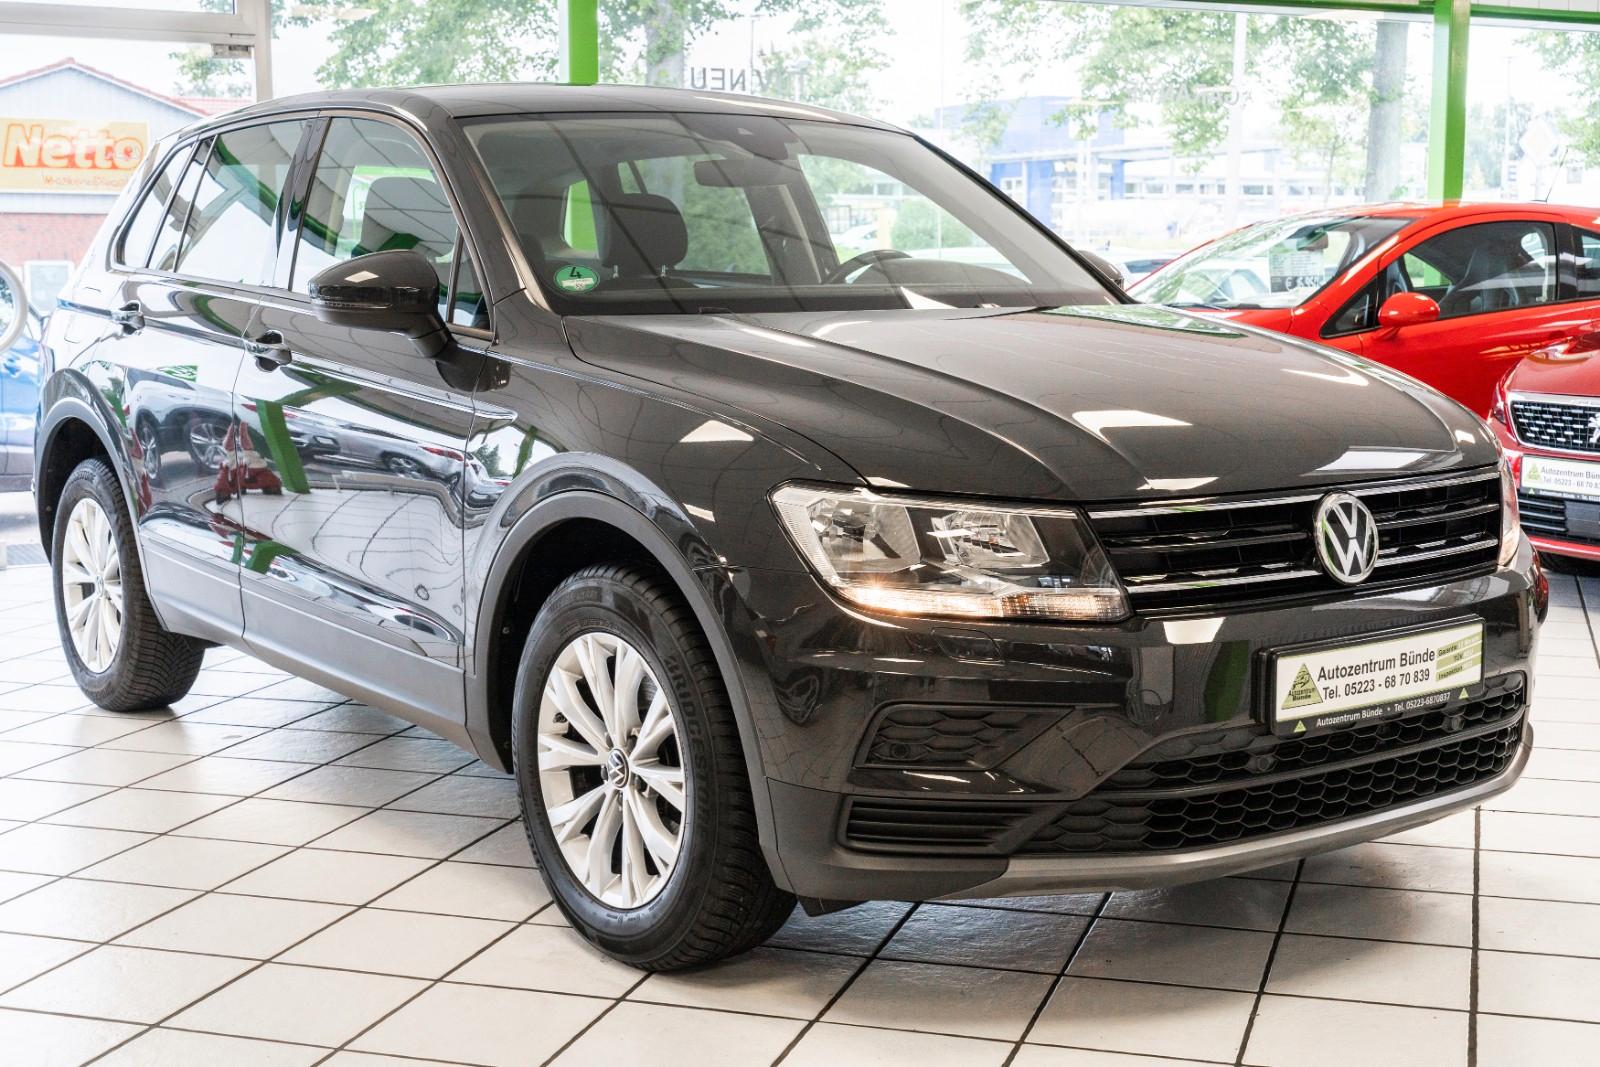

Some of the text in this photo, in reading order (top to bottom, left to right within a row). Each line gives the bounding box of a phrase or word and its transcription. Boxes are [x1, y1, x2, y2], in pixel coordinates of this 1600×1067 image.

[3, 123, 144, 170] Netto
[569, 266, 582, 278] 4
[1317, 648, 1435, 682] Autozentrum Bünde
[1323, 685, 1341, 699] Tel.
[1344, 680, 1375, 697] 05223
[1384, 677, 1396, 691] 68
[1399, 672, 1411, 686] 70
[1413, 668, 1430, 683] 839
[1316, 712, 1361, 727] Autozentrum
[1361, 707, 1383, 719] Bünde
[1394, 703, 1404, 712] Tel.
